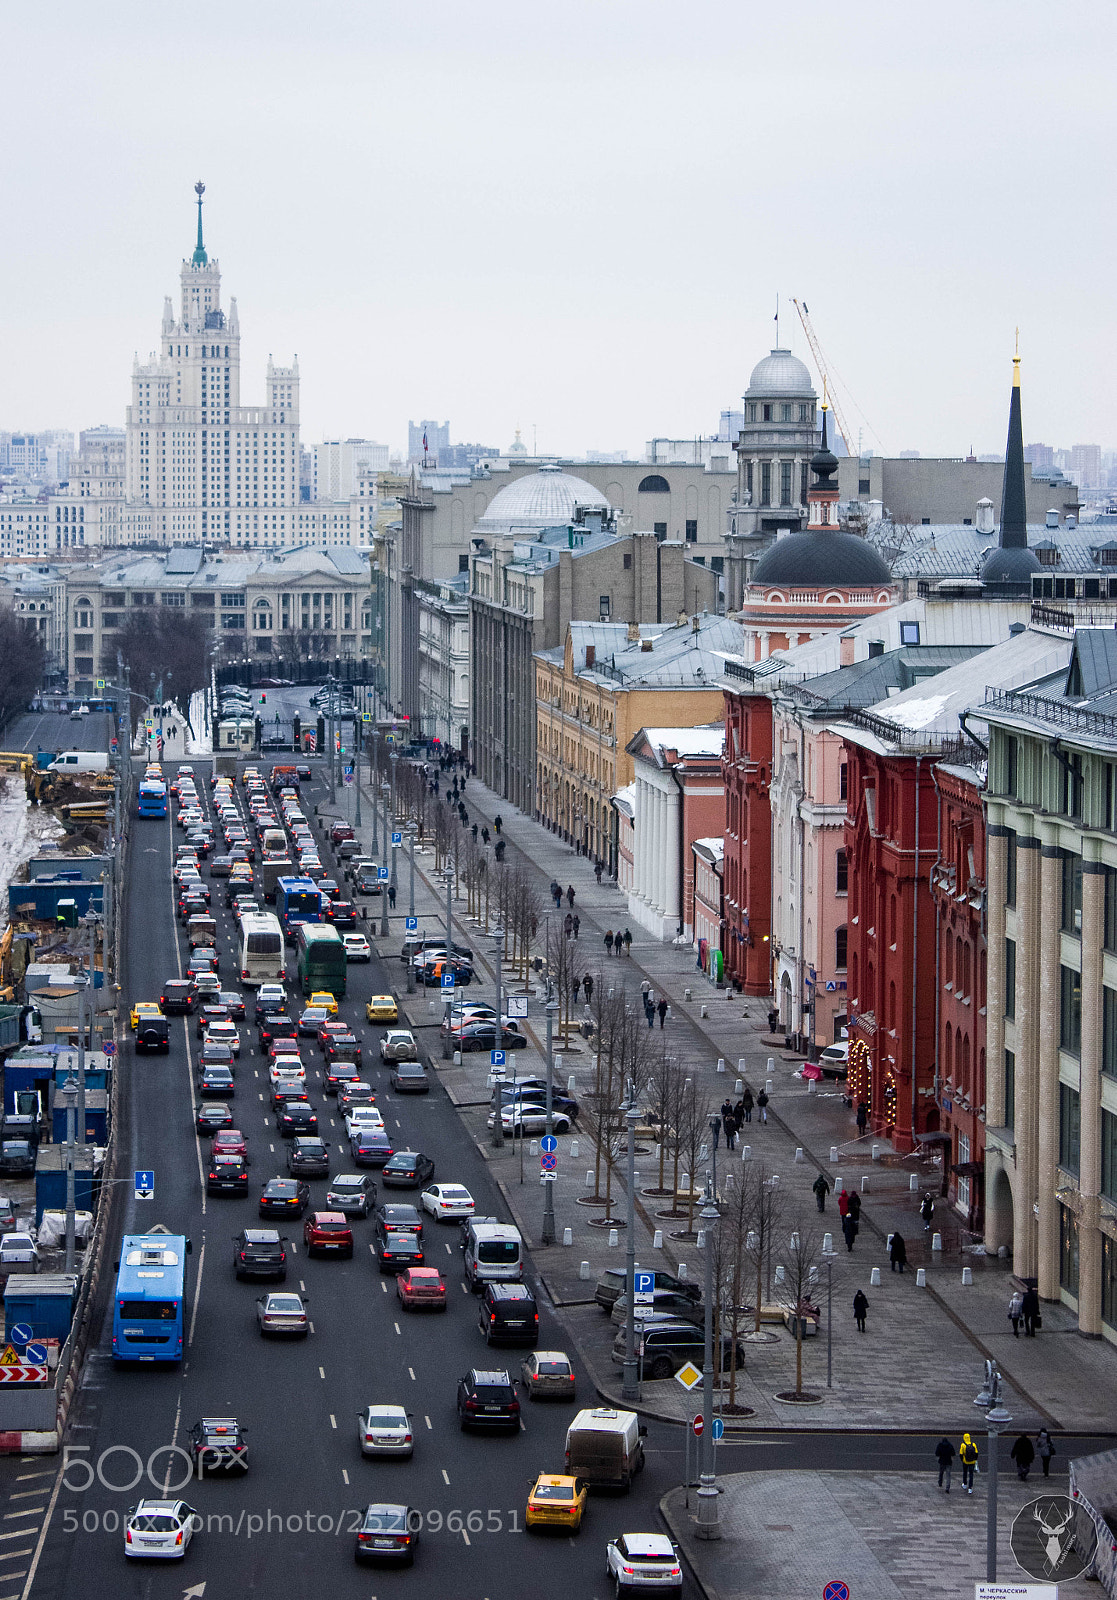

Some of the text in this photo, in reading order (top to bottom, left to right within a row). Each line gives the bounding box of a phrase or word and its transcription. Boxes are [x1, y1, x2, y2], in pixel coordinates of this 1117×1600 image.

[394, 834, 400, 842] P
[380, 869, 386, 877] P
[408, 919, 415, 927] P
[444, 976, 452, 986] P
[495, 1052, 503, 1063] P
[640, 1275, 651, 1291] P
